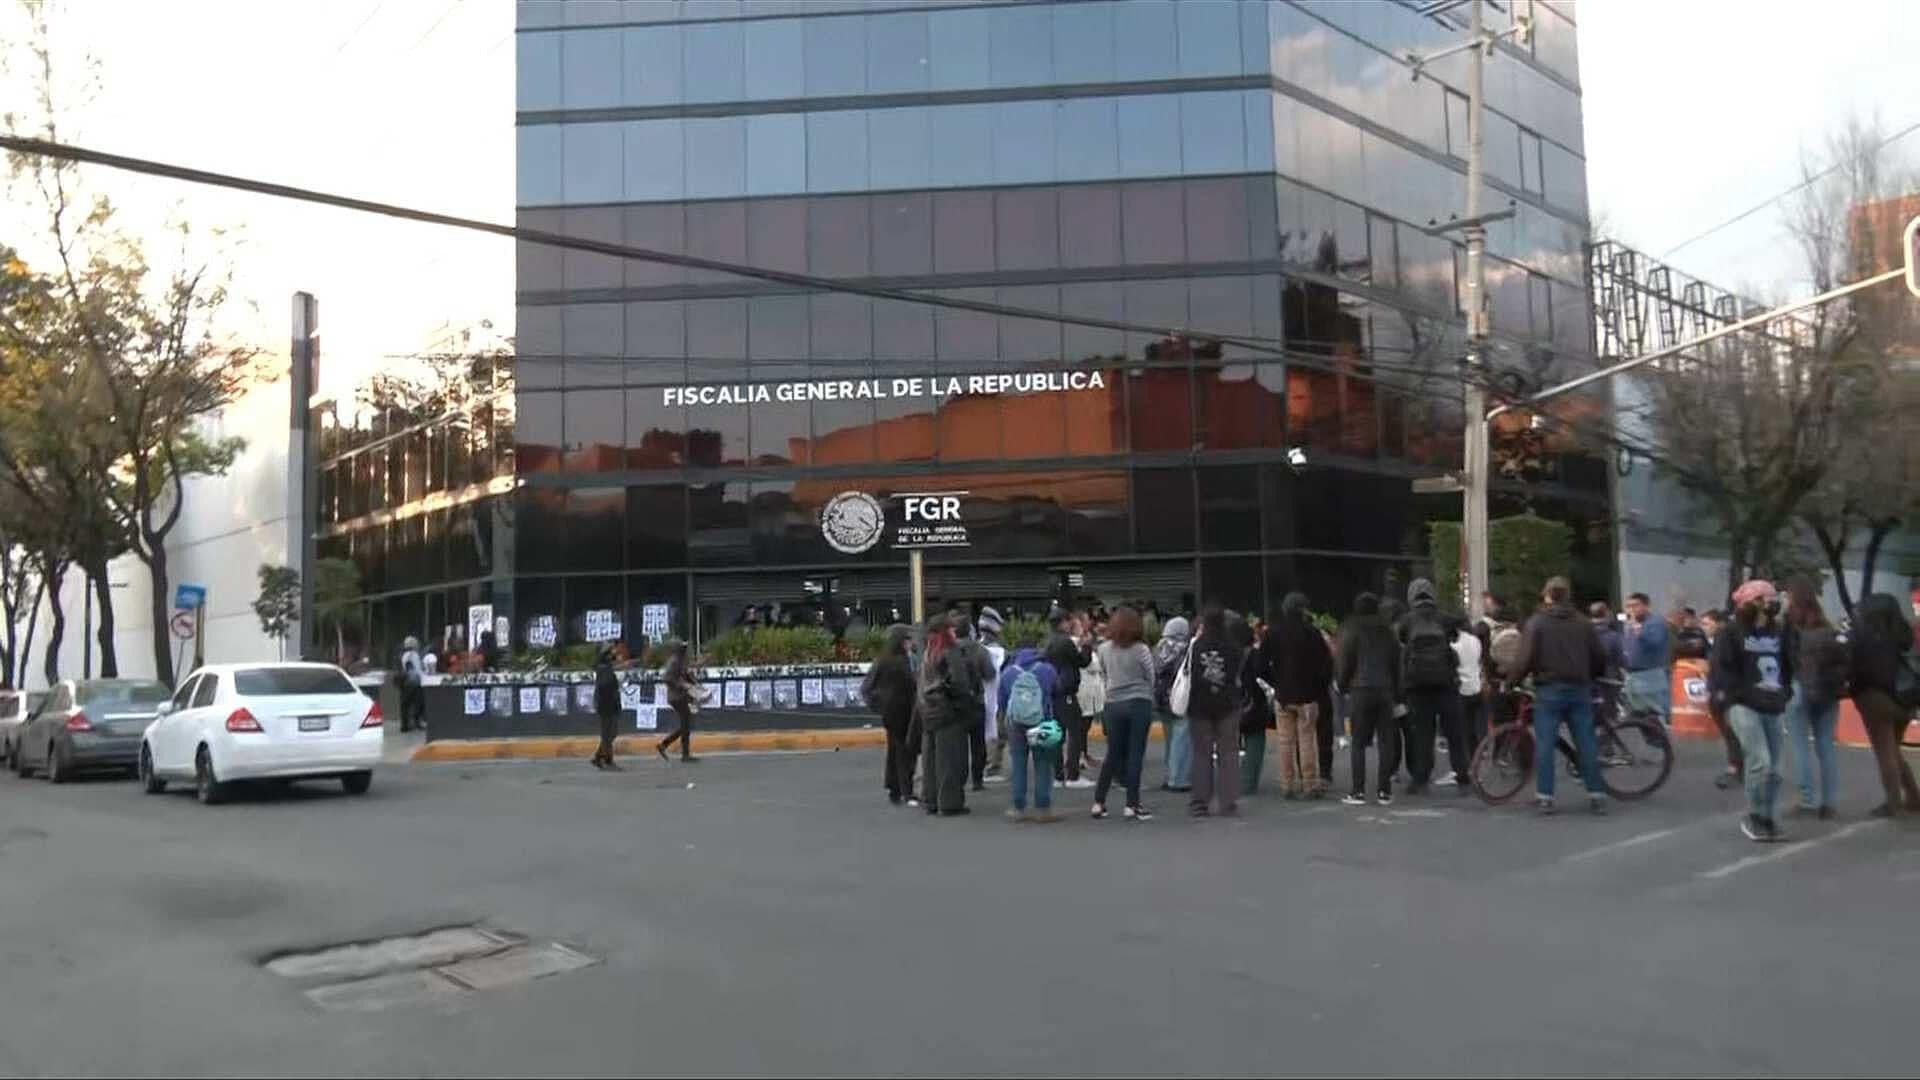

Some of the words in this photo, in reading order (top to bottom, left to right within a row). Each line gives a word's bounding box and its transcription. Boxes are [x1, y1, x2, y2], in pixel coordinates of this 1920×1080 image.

[663, 385, 770, 406] FISCALIA
[776, 379, 886, 401] GENERAL
[893, 378, 922, 397] DE
[931, 376, 962, 395] LA
[969, 370, 1104, 394] REPUBLICA
[905, 497, 960, 521] FGR
